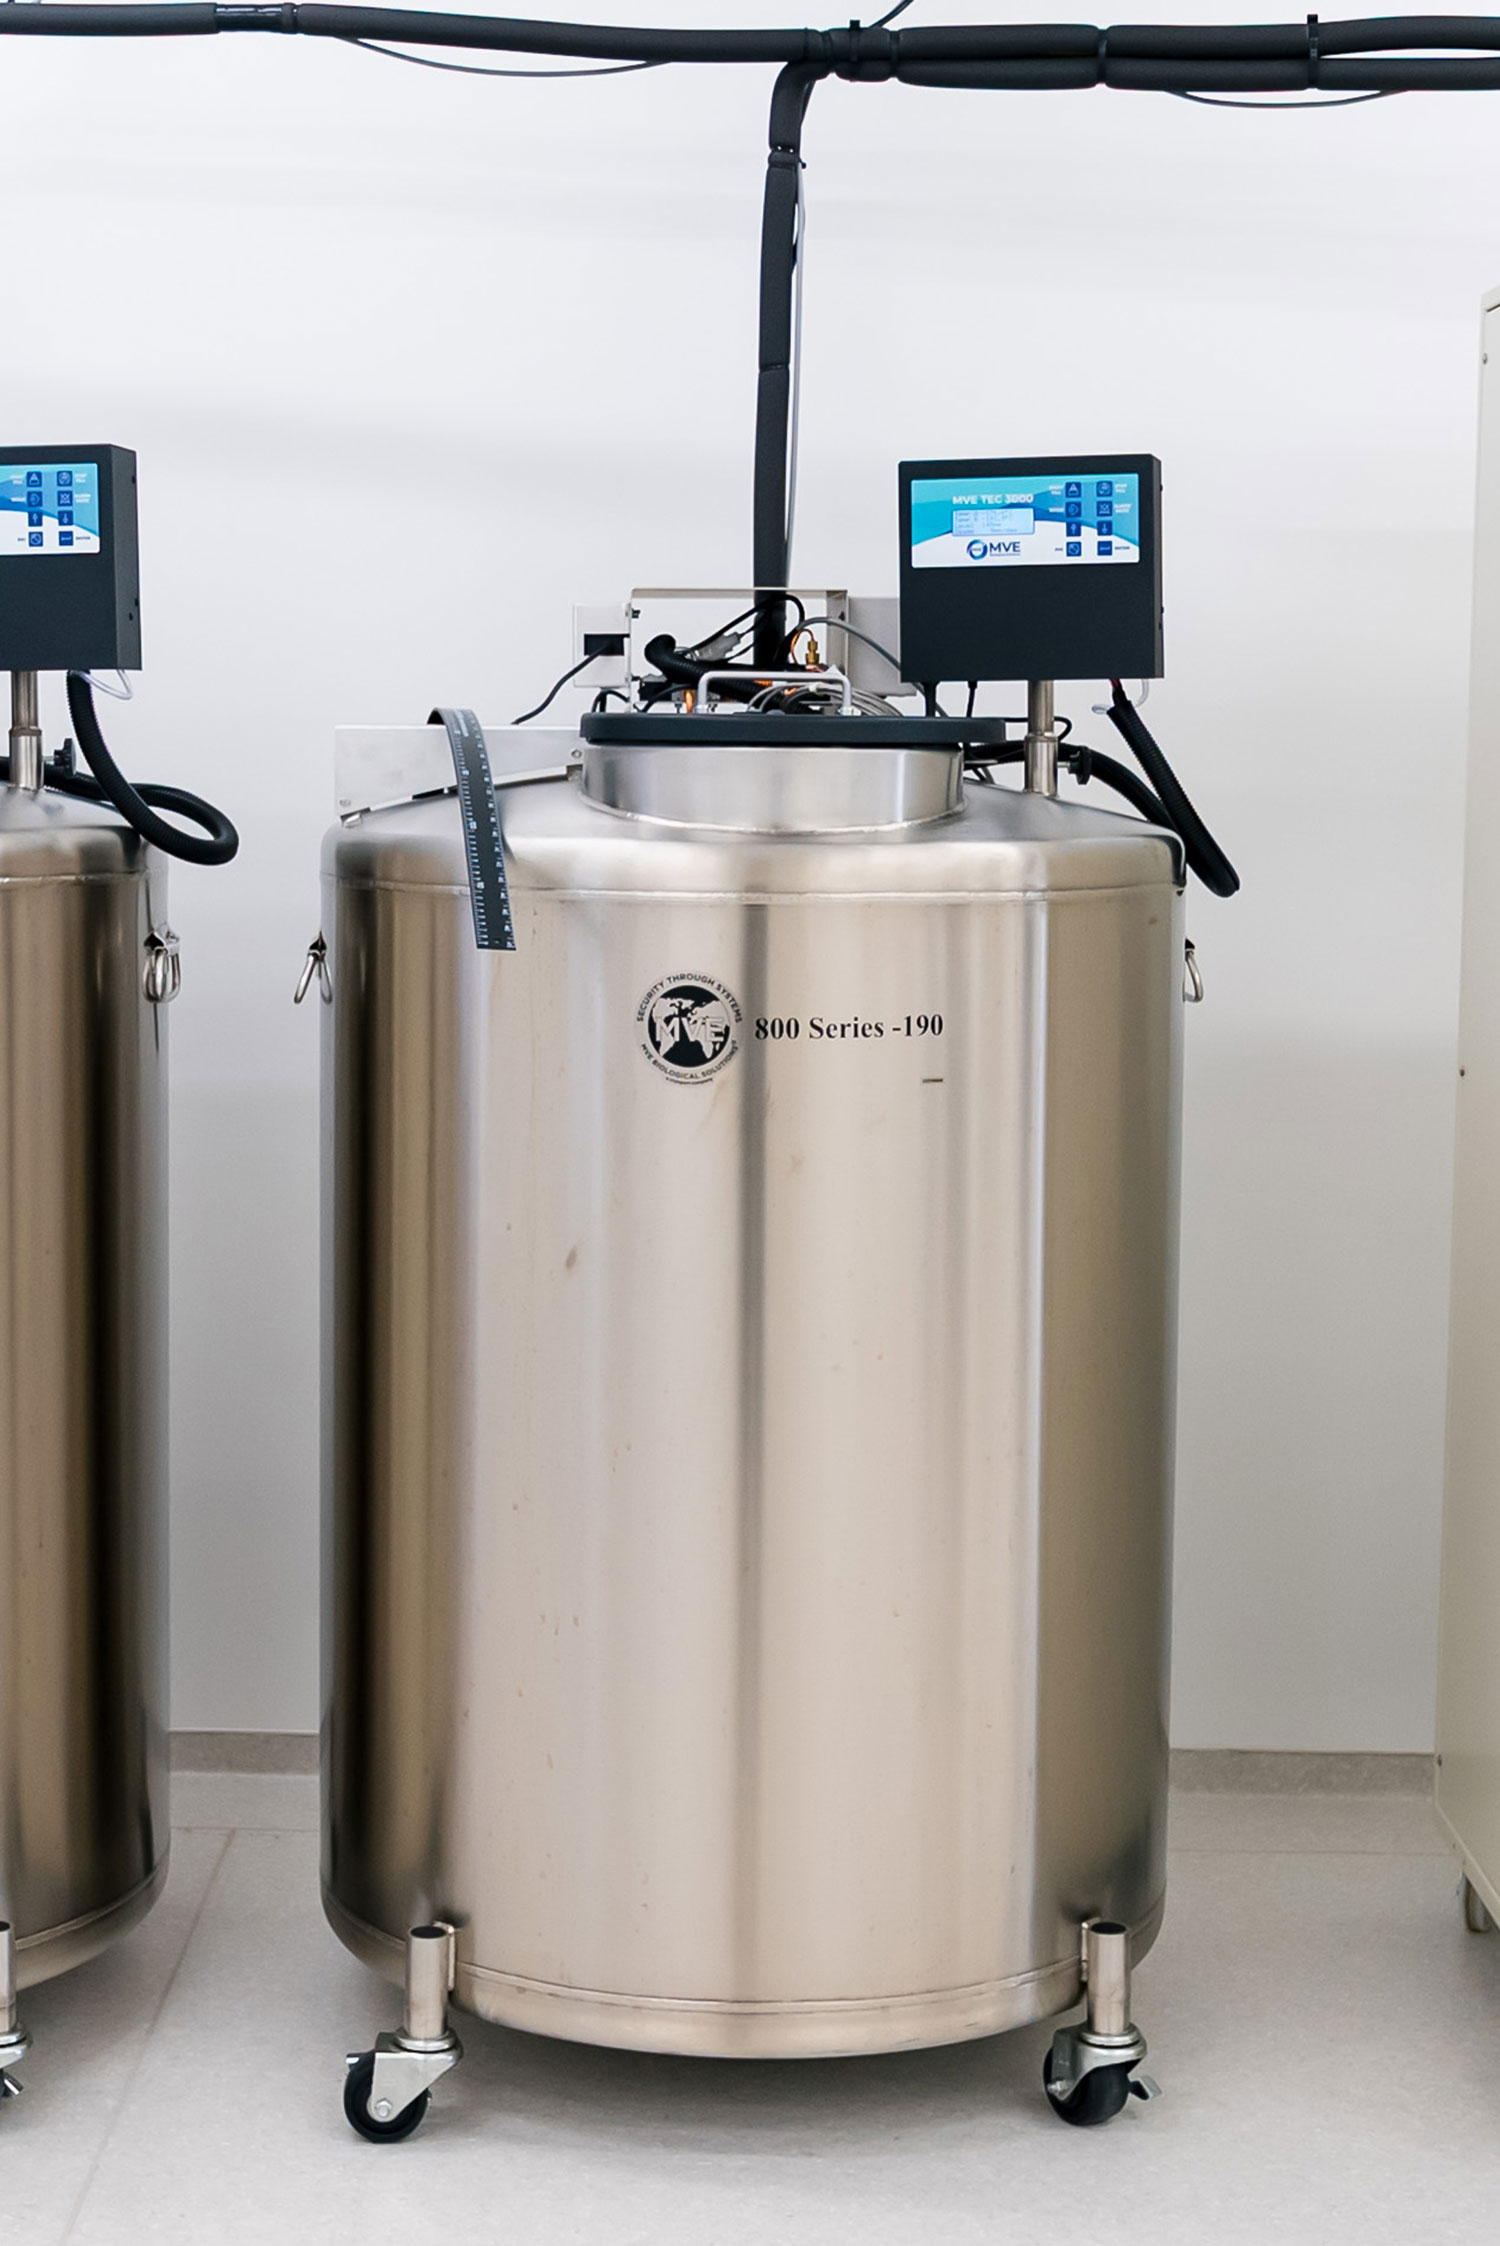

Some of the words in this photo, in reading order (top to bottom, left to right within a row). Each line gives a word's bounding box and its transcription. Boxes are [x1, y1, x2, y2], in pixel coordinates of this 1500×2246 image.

[952, 496, 977, 505] MVE
[979, 495, 1002, 504] TEC
[1005, 494, 1034, 503] 3000
[989, 541, 1021, 553] MVE
[637, 981, 664, 1022] SECURITY
[666, 973, 716, 987] THROUGH
[716, 983, 743, 1023] SYSTEMS
[655, 1017, 725, 1042] MVE
[754, 1017, 800, 1040] 800
[809, 1016, 884, 1039] Series
[892, 1014, 944, 1037] -190
[641, 1043, 654, 1061] MVE
[652, 1059, 700, 1080] BIOLOGICAL
[701, 1043, 739, 1078] SOLUTIONS
